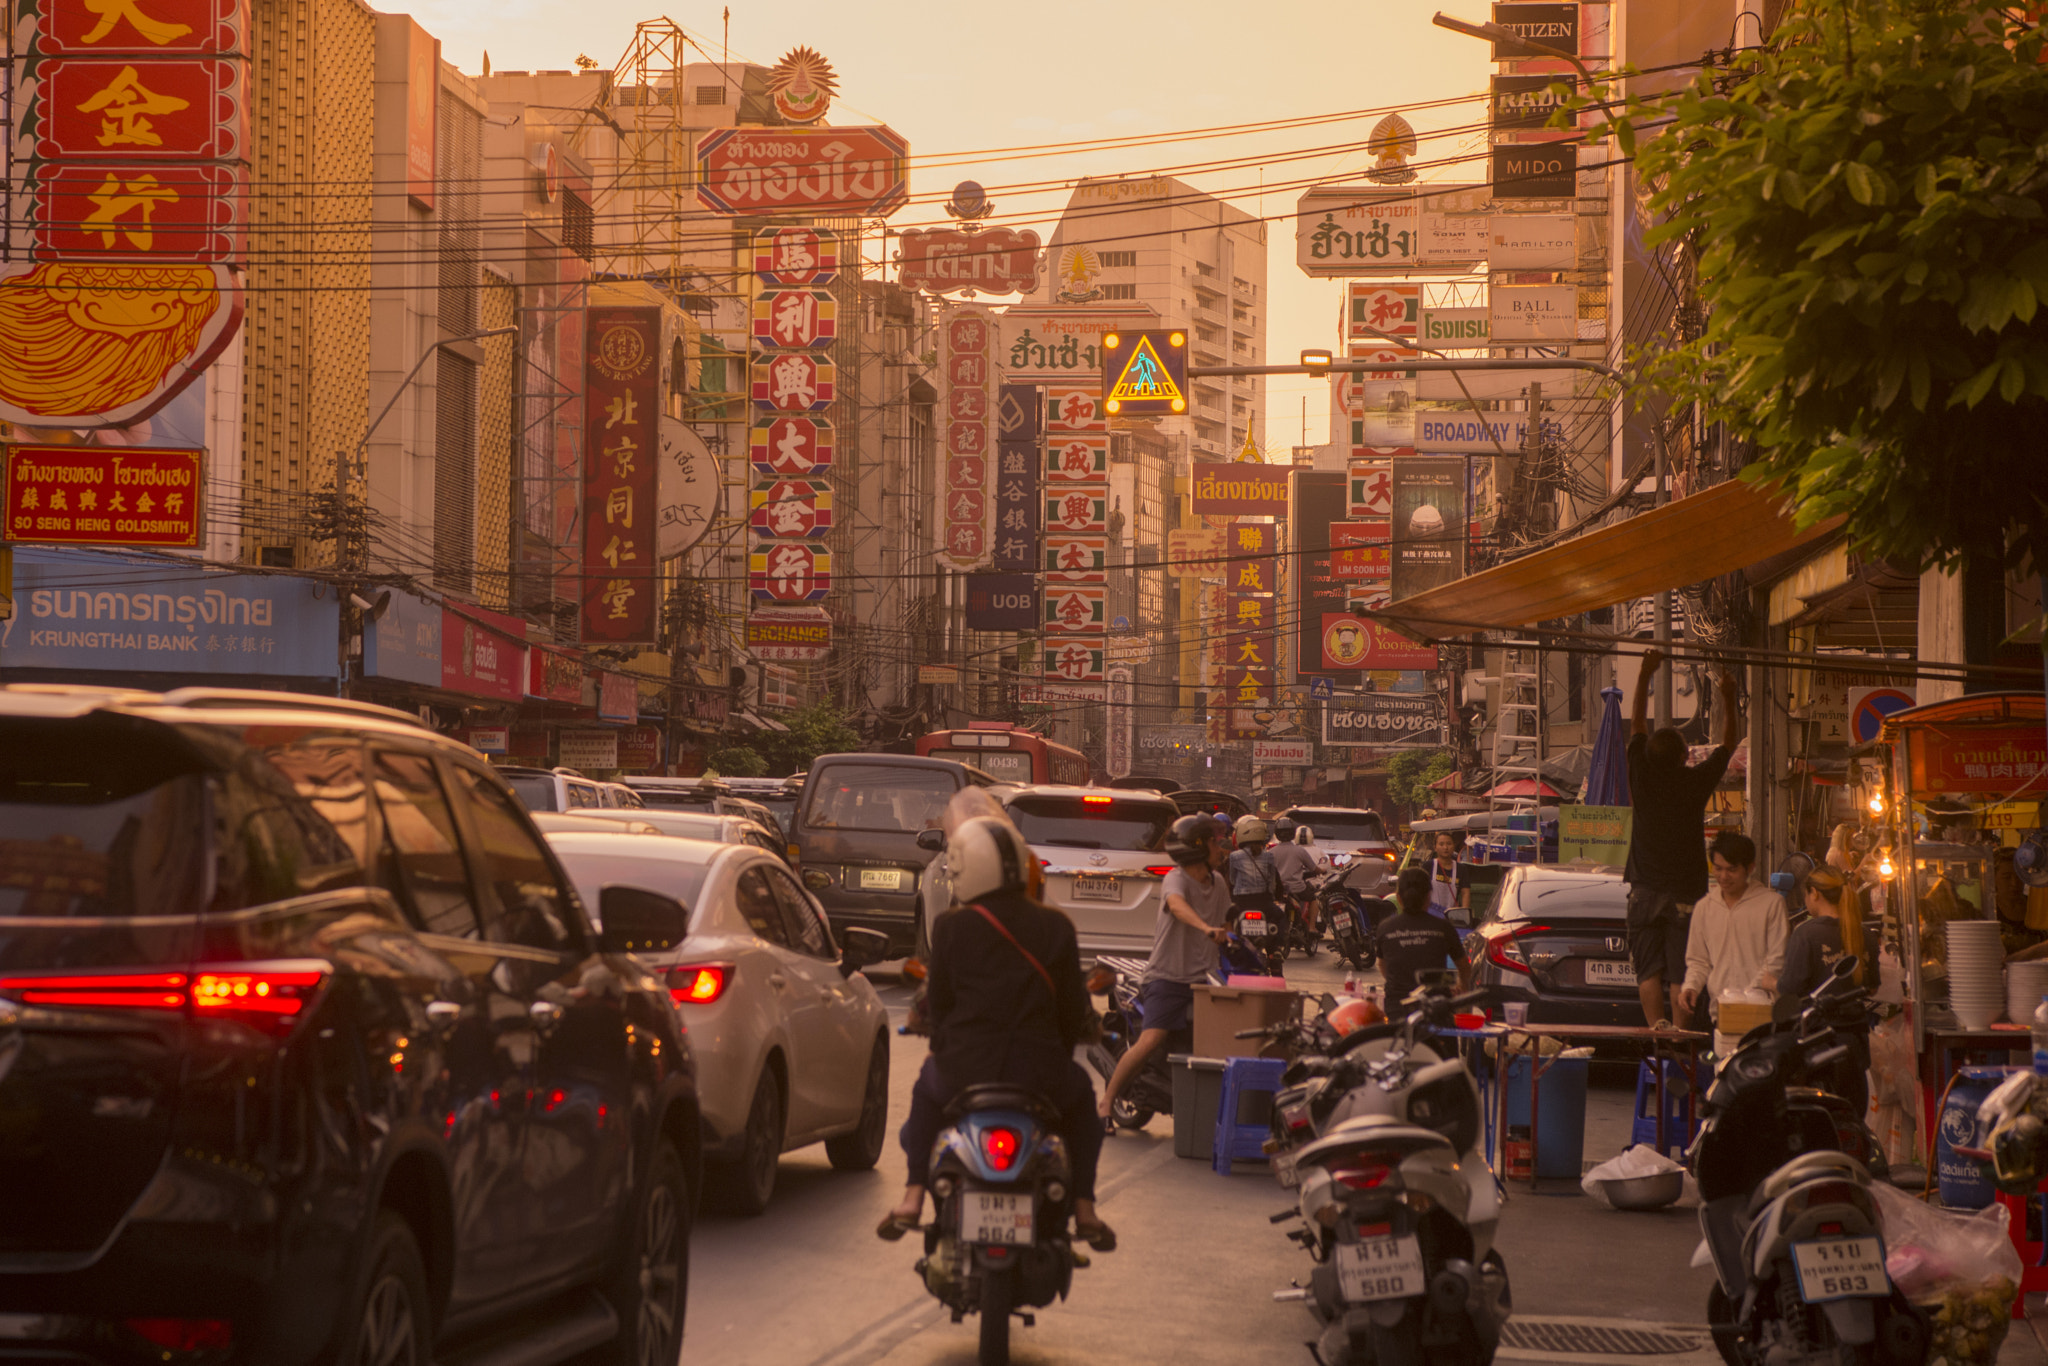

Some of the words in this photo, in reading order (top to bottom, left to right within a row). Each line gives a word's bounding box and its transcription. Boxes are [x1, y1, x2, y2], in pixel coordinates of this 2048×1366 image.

[1506, 160, 1562, 174] MIDO
[1512, 300, 1555, 312] BALL
[1423, 421, 1510, 442] BROADWAY
[1515, 422, 1567, 443] HTEL
[14, 516, 32, 529] SO
[36, 516, 71, 531] SENG
[75, 517, 111, 532] HENG
[115, 518, 189, 534] GOLDSMITH
[1353, 565, 1375, 575] SOON
[992, 594, 1032, 609] UOB
[30, 589, 273, 632] ธนาคารกรุงไทย
[29, 630, 142, 650] KRUNGTHAI
[147, 632, 198, 651] BANK
[749, 625, 828, 642] EXCHANGE
[1563, 837, 1590, 846] Mango
[1591, 837, 1628, 846] Smoothie
[1096, 881, 1119, 892] 3749
[1361, 1275, 1404, 1297] 580
[1823, 1274, 1868, 1294] 583
